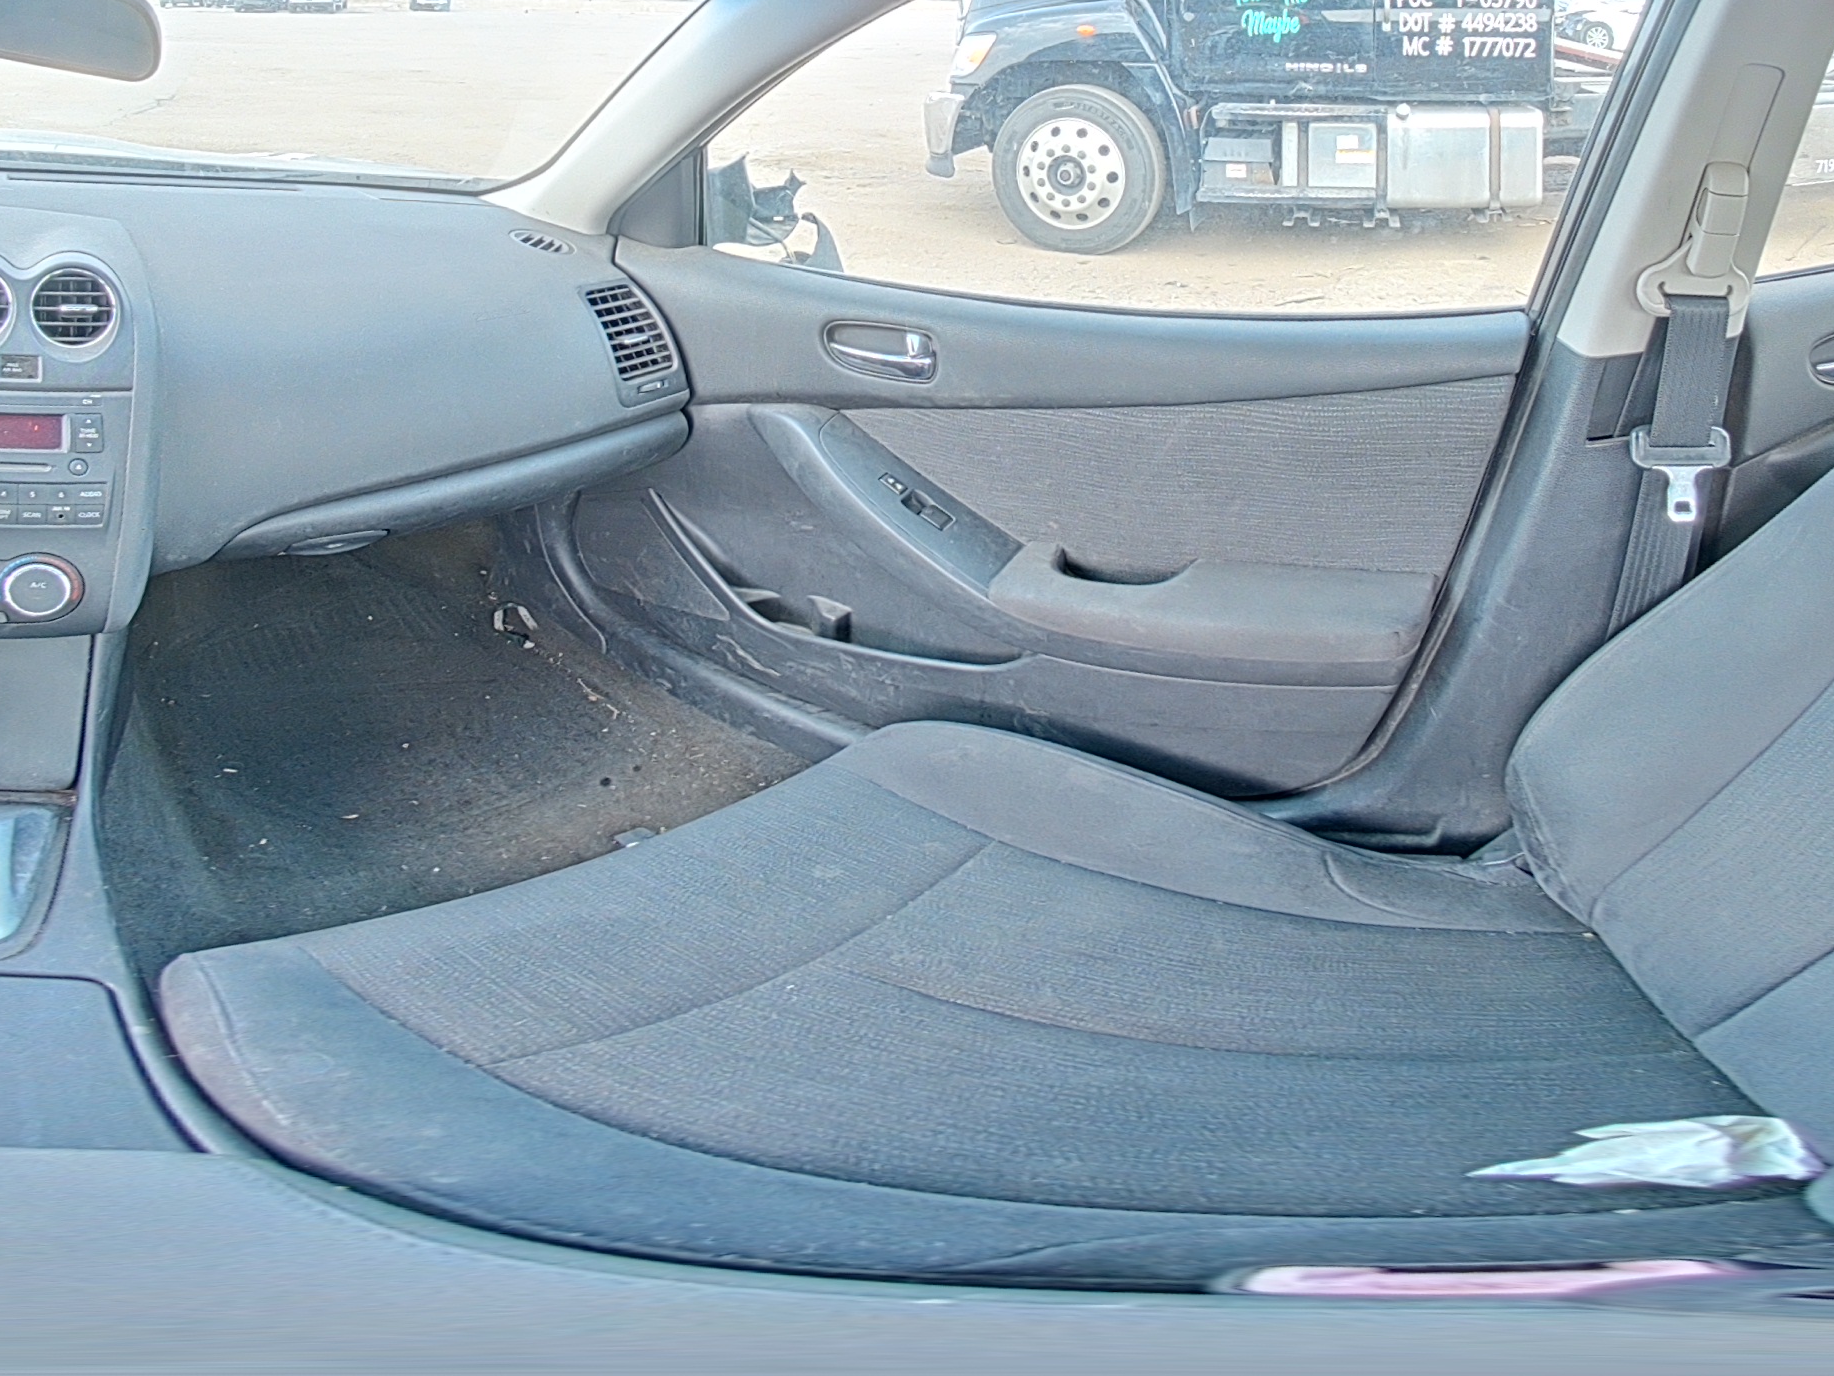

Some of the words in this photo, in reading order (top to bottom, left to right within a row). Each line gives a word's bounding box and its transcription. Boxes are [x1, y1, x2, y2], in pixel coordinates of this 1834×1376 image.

[1241, 9, 1300, 43] Maybe
[1399, 13, 1432, 32] DOT
[1438, 13, 1455, 33] #
[1462, 13, 1537, 32] 4494238
[1402, 36, 1430, 56] MC
[1436, 36, 1453, 56] #
[1462, 37, 1536, 58] 1777072
[30, 581, 46, 589] A/C
